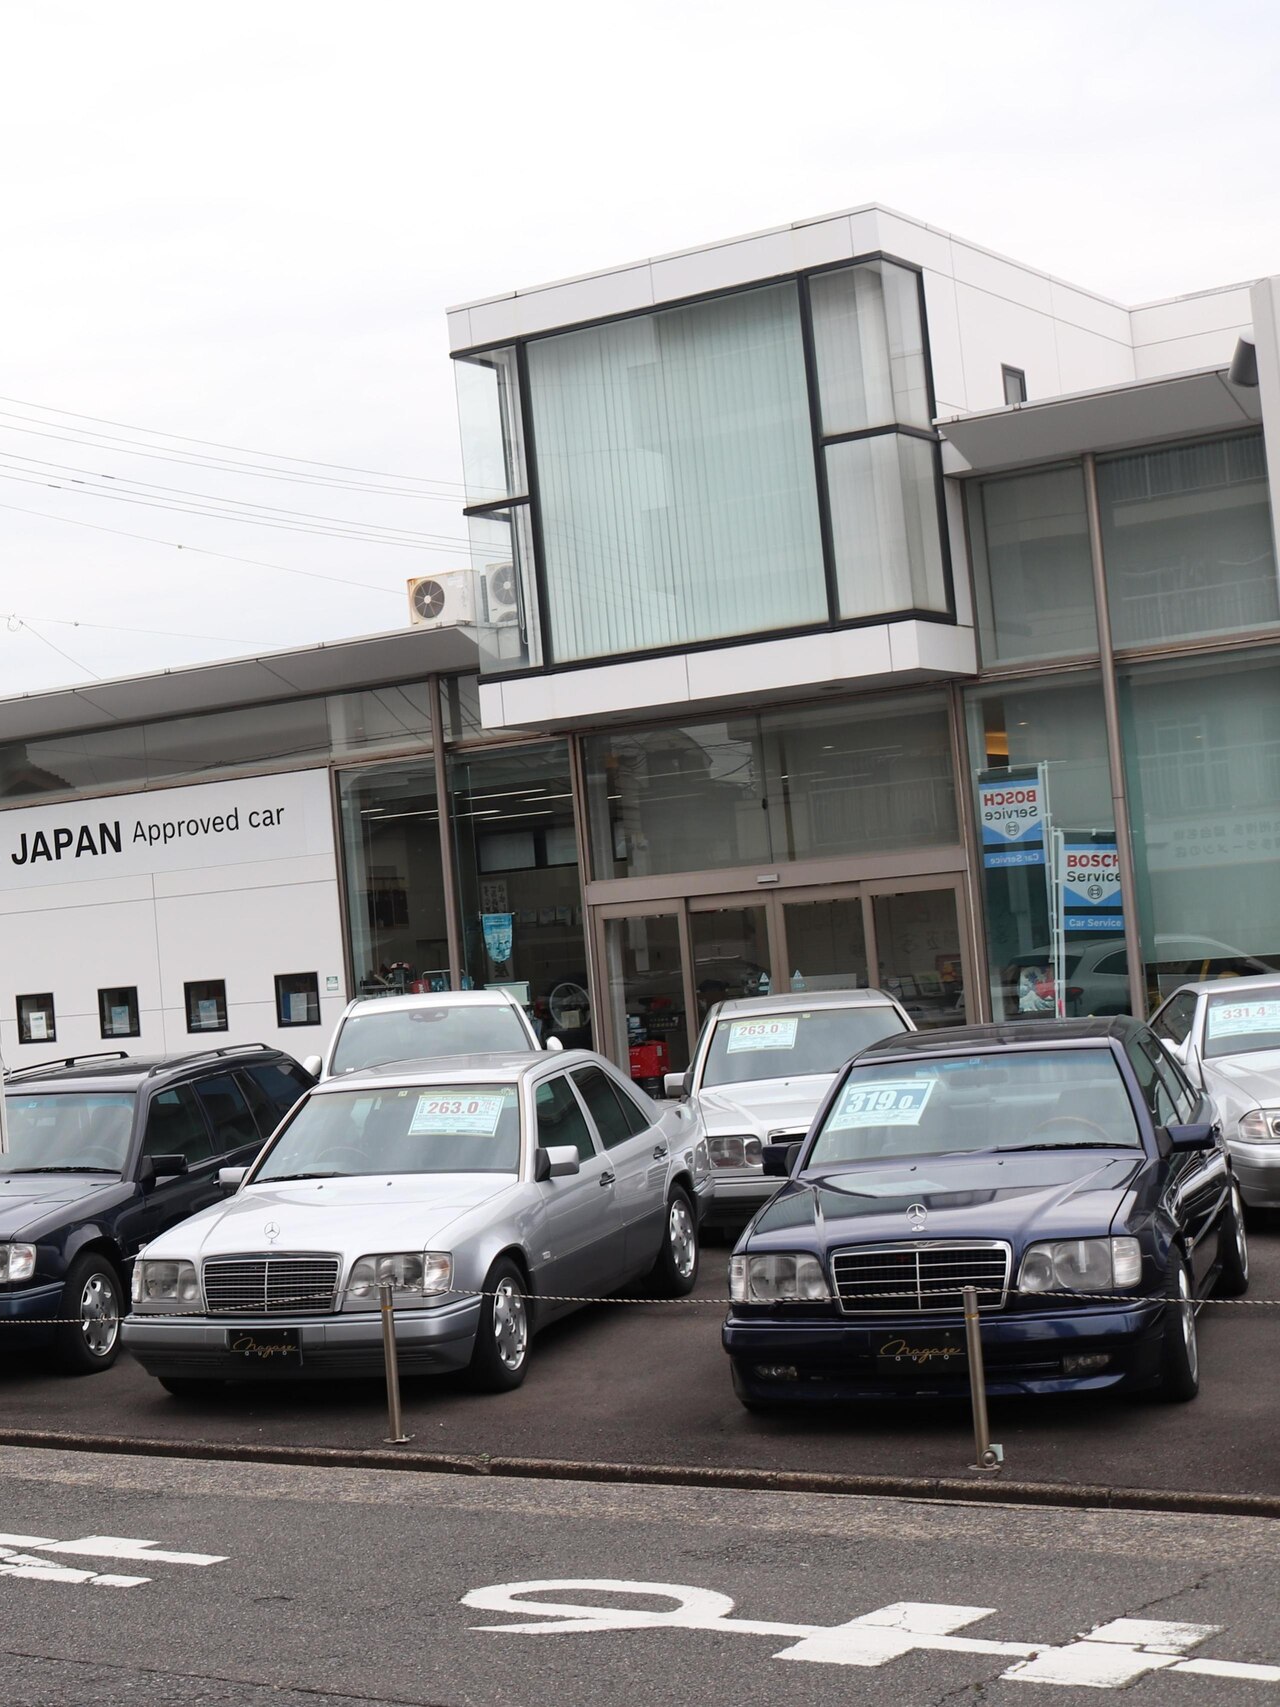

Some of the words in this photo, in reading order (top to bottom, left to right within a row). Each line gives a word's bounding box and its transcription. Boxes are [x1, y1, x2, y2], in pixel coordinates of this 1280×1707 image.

[11, 821, 122, 865] JAPAN
[132, 807, 239, 845] Approved
[248, 805, 285, 830] car
[1066, 870, 1120, 882] Service
[1069, 919, 1086, 927] Car
[1087, 919, 1121, 927] Service
[1222, 1006, 1266, 1020] 331.4
[740, 1024, 779, 1036] 263.0
[427, 1101, 479, 1114] 263.0
[846, 1090, 914, 1113] 319.0
